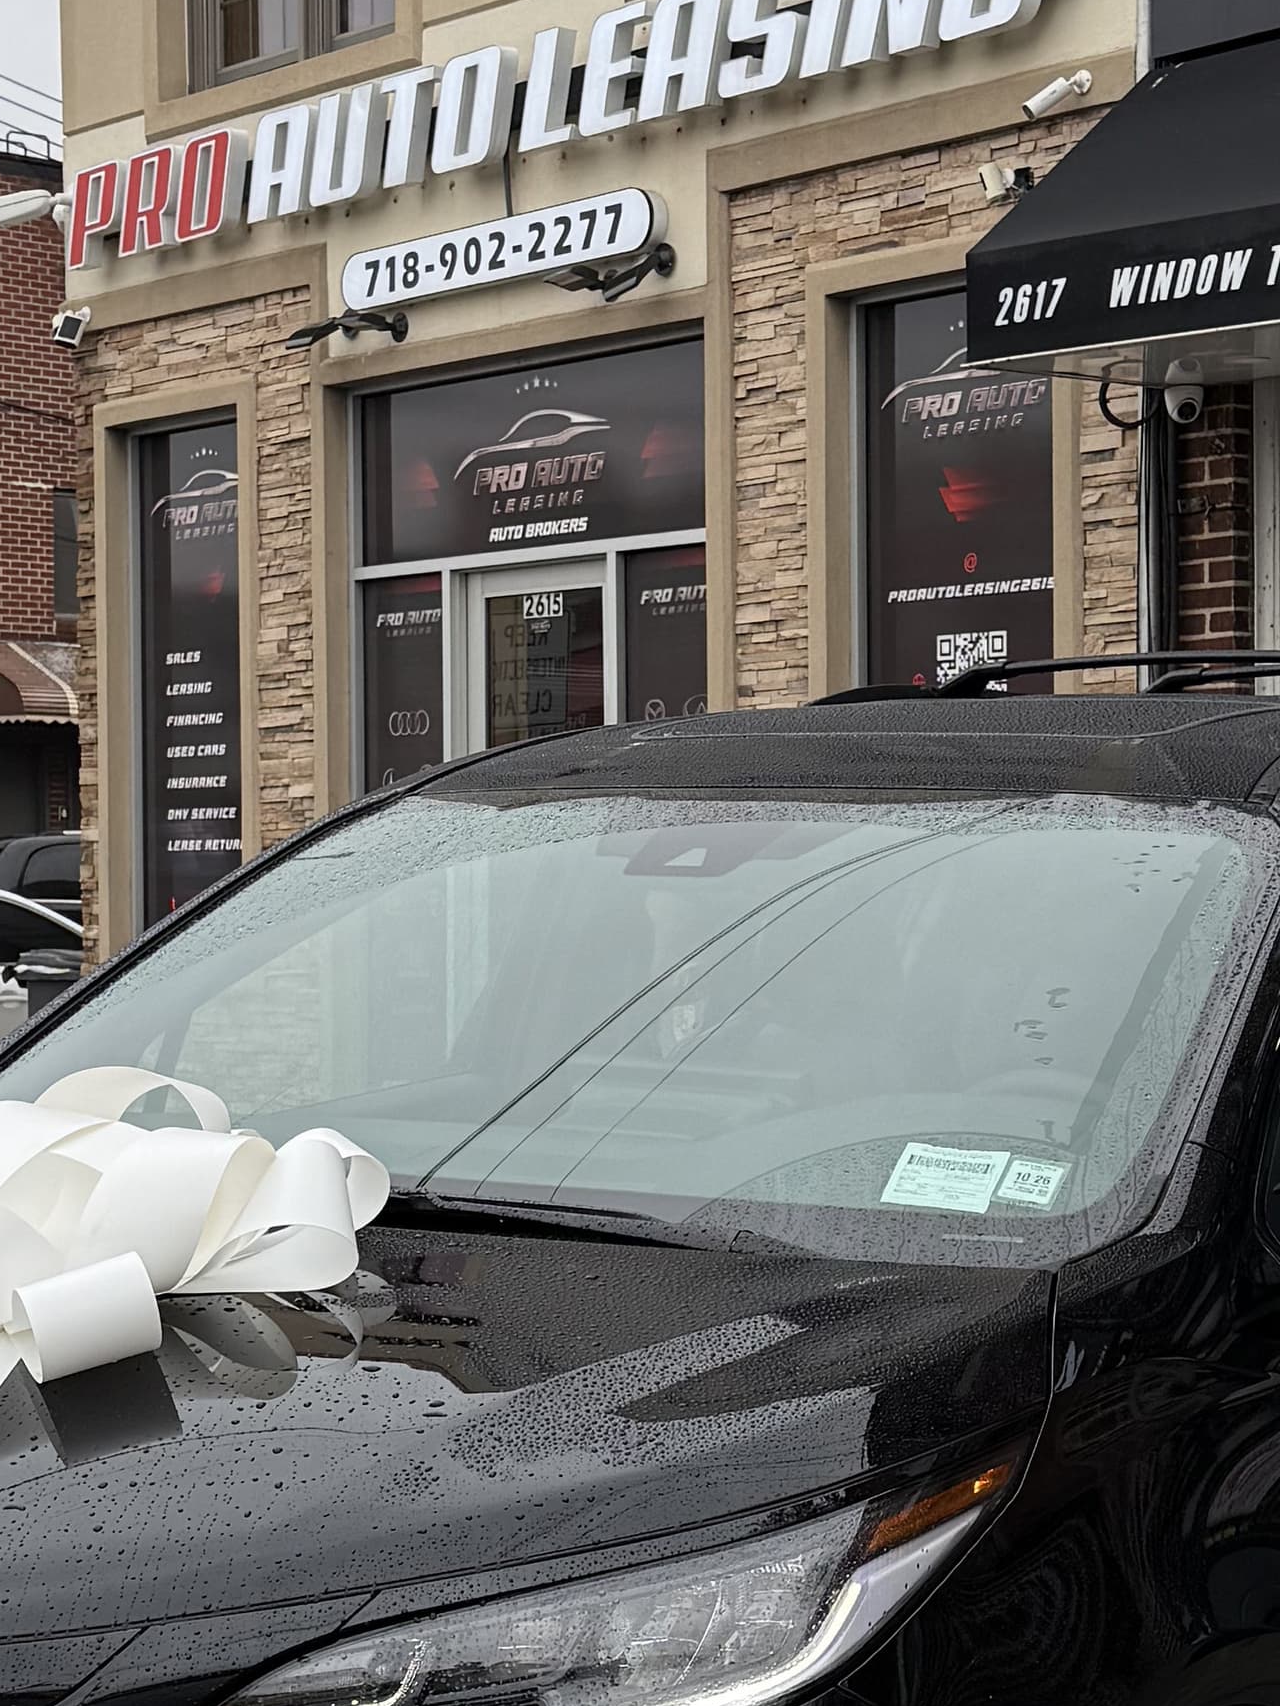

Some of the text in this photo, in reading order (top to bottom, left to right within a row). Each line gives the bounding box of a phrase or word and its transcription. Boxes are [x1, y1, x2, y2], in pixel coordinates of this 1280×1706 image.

[69, 129, 246, 270] PRO
[247, 45, 517, 224] AUTO
[365, 204, 623, 298] 718-902-2277
[1109, 248, 1251, 308] WINDOW
[995, 277, 1066, 326] 2617
[902, 378, 1048, 423] PRO AUTO
[923, 413, 1024, 439] LEASING
[473, 452, 606, 495] PRO AUTO
[493, 489, 584, 514] LEASING
[163, 499, 238, 528] PRO AUT
[176, 523, 235, 540] LEASING
[489, 517, 588, 542] AUTO BROKERS
[964, 553, 977, 572] @
[640, 588, 673, 605] PRO
[888, 577, 1055, 603] PROAUTOLEASING2615
[525, 594, 561, 617] 2615
[377, 609, 441, 627] PRO AUTO
[166, 651, 201, 664] SALES
[166, 682, 212, 695] LEASING
[167, 713, 223, 727] FINANCING
[167, 744, 226, 758] USED CARS
[167, 776, 227, 789] INSURANCE
[168, 807, 236, 820] DMV SERVICE
[168, 838, 243, 851] LEASE RETUR
